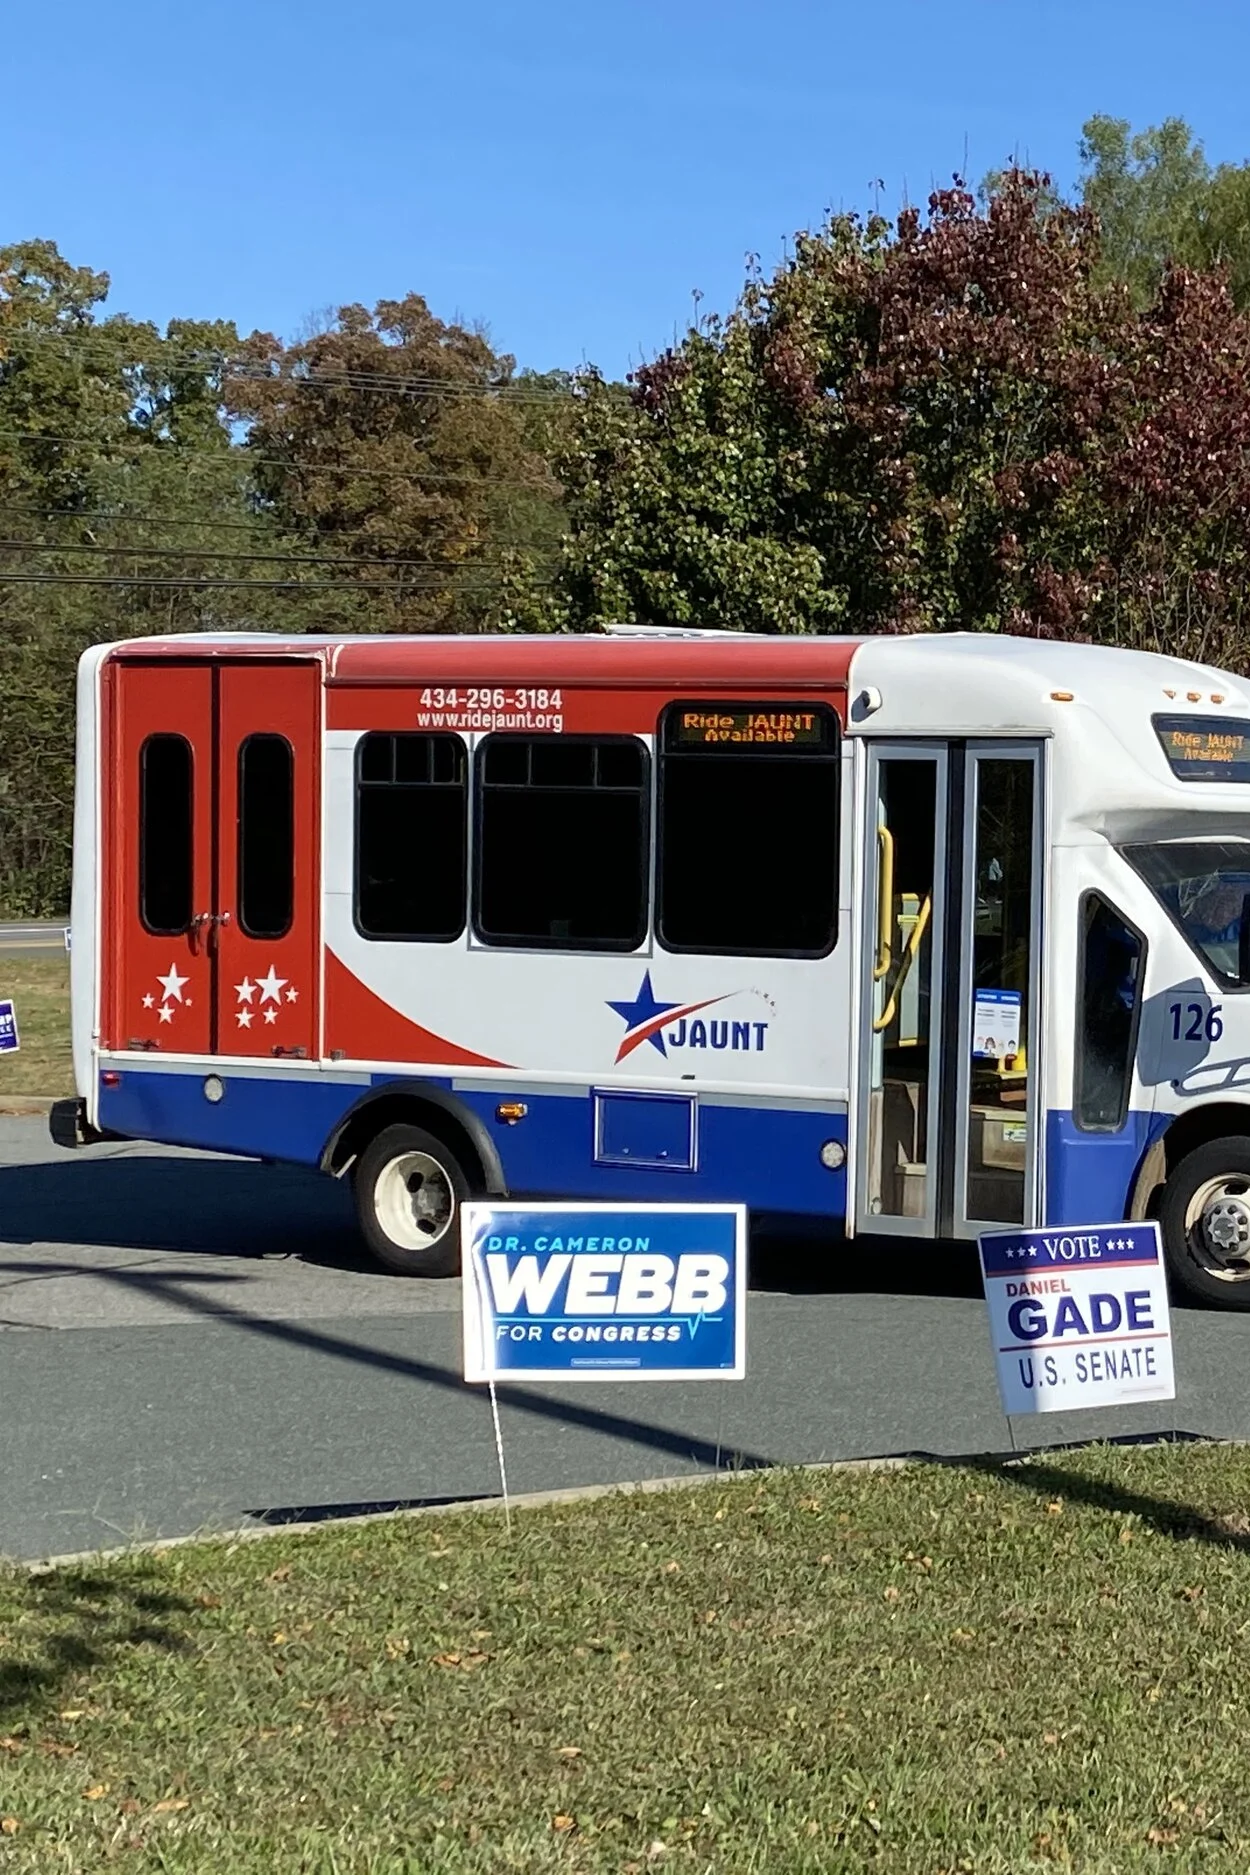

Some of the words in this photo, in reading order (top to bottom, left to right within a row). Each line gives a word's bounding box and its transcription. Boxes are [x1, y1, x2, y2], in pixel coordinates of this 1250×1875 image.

[420, 688, 563, 709] 434-296-3184
[417, 709, 563, 733] www.ridejaunt.org
[684, 713, 735, 728] Ride
[745, 714, 815, 730] JAUNT
[704, 729, 796, 743] Available
[1206, 733, 1245, 750] JAUNT
[1169, 1003, 1223, 1042] 126
[668, 1018, 769, 1051] JAUNT
[488, 1236, 527, 1252] DR.
[534, 1236, 651, 1252] CAMERON
[1043, 1235, 1102, 1261] VOTE
[485, 1253, 730, 1315] WEBB
[1006, 1278, 1071, 1298] DANIEL
[1007, 1290, 1155, 1341] GADE
[495, 1325, 543, 1342] FOR
[551, 1325, 682, 1342] CONGRESS
[1018, 1355, 1067, 1389] U.S.
[1074, 1346, 1157, 1384] SENATE
